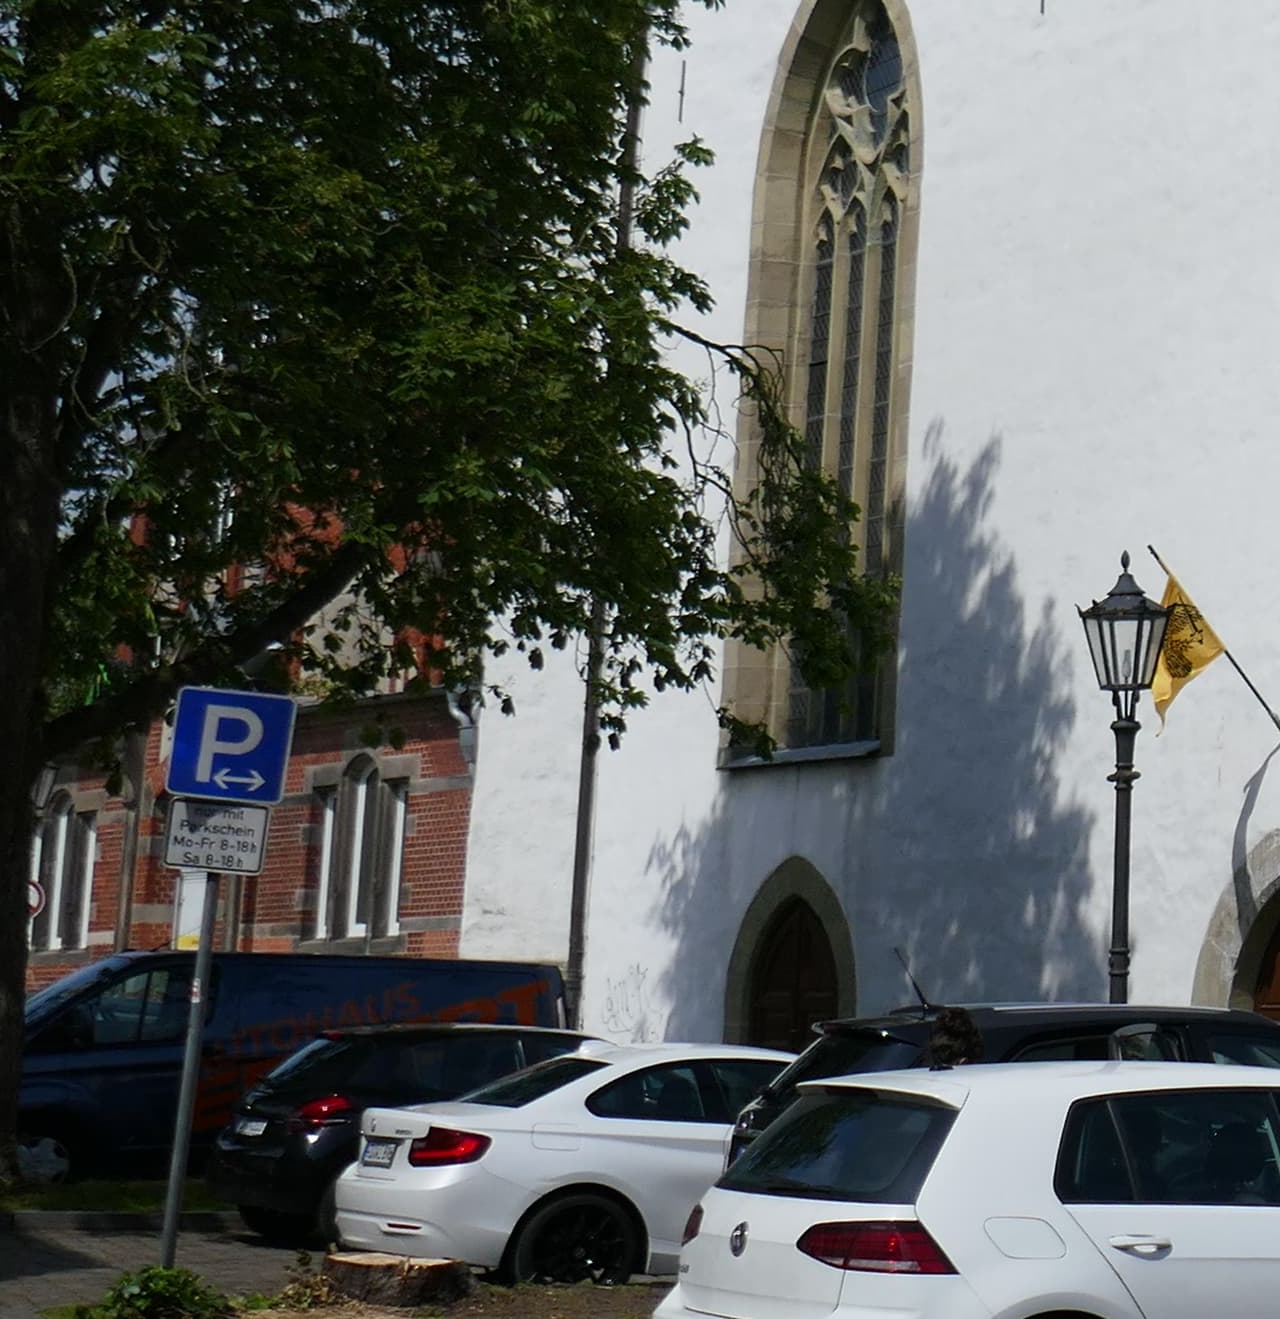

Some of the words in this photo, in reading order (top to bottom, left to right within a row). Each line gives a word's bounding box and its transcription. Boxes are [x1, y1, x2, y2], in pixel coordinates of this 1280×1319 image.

[196, 704, 264, 783] P
[223, 809, 244, 821] mit
[180, 818, 255, 838] Parkschein
[173, 836, 216, 850] Mo-Fr
[183, 852, 200, 864] Sa
[208, 979, 422, 1063] UTOHAUS
